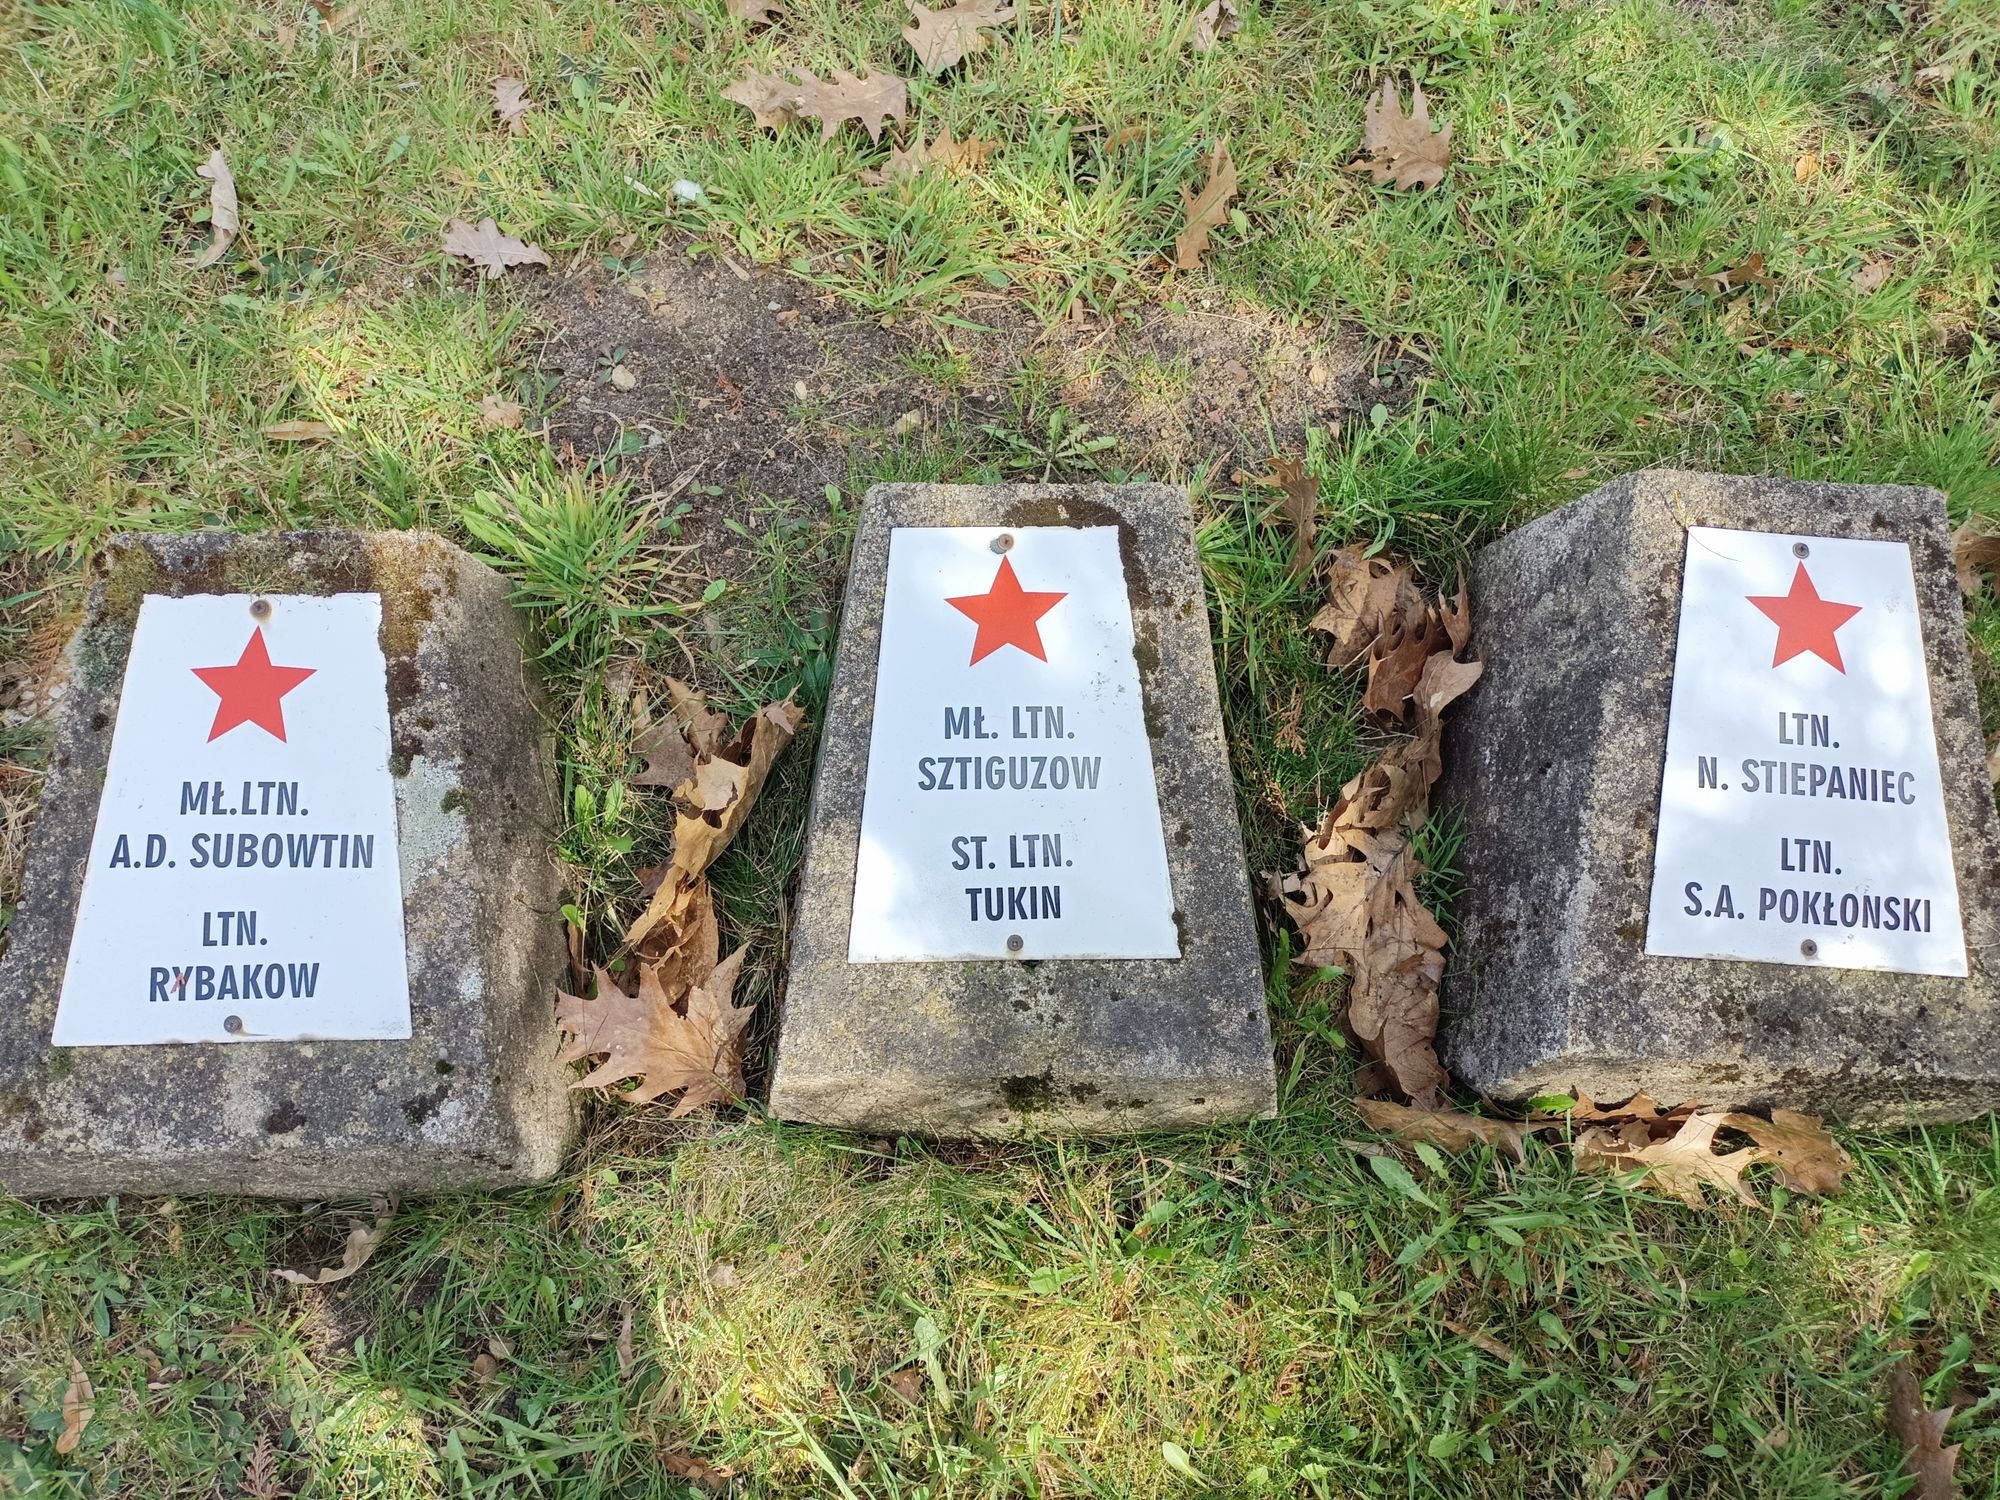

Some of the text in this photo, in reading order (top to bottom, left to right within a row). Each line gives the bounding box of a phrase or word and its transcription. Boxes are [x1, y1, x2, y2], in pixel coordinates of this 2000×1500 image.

[944, 706, 1075, 740] MŁ. LTN.
[1778, 711, 1840, 749] LTN.
[919, 755, 1101, 791] SZTIGUZOW
[1698, 756, 1916, 806] N. STIEPANIEC
[109, 833, 374, 869] A.D. SUBOWTIN
[952, 833, 1074, 871] ST. LTN.
[1781, 837, 1842, 876] LTN.
[964, 886, 1062, 922] TUKIN
[1683, 881, 1931, 934] S.A. POKŁONSKI
[202, 911, 268, 947] LTN.
[149, 964, 320, 1003] RYBAKOW
